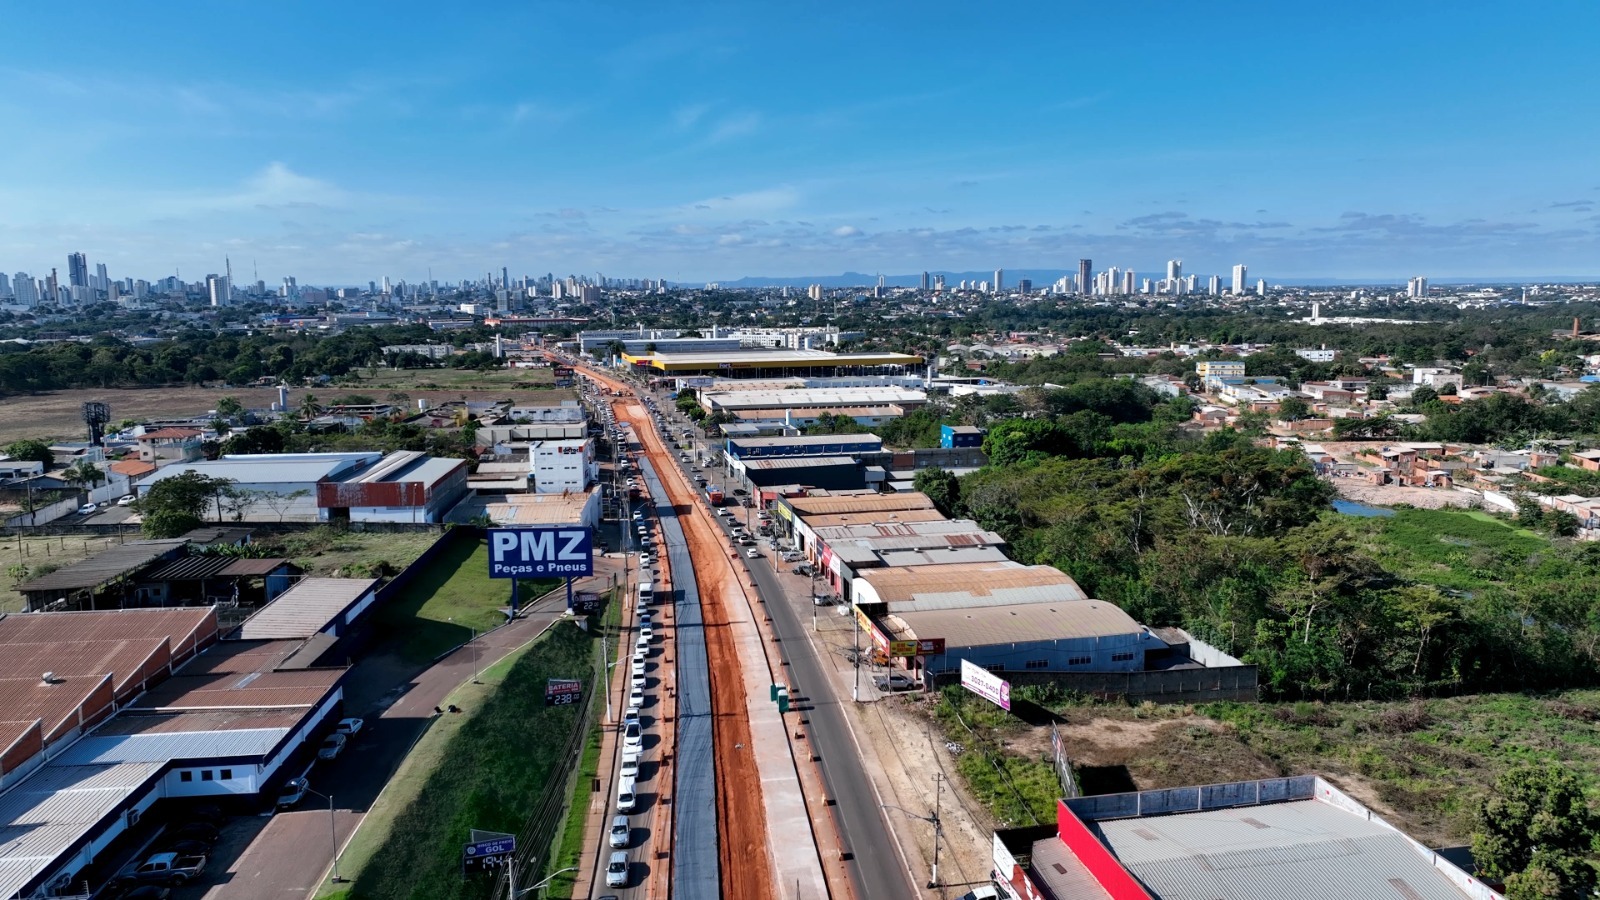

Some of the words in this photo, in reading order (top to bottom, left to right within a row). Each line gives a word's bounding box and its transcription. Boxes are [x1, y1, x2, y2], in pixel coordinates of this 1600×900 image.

[493, 531, 587, 561] PMZ
[494, 563, 533, 575] Peças
[548, 562, 587, 572] Pneus
[548, 682, 579, 691] BATERIA
[554, 693, 572, 705] 238
[485, 845, 504, 853] GOL
